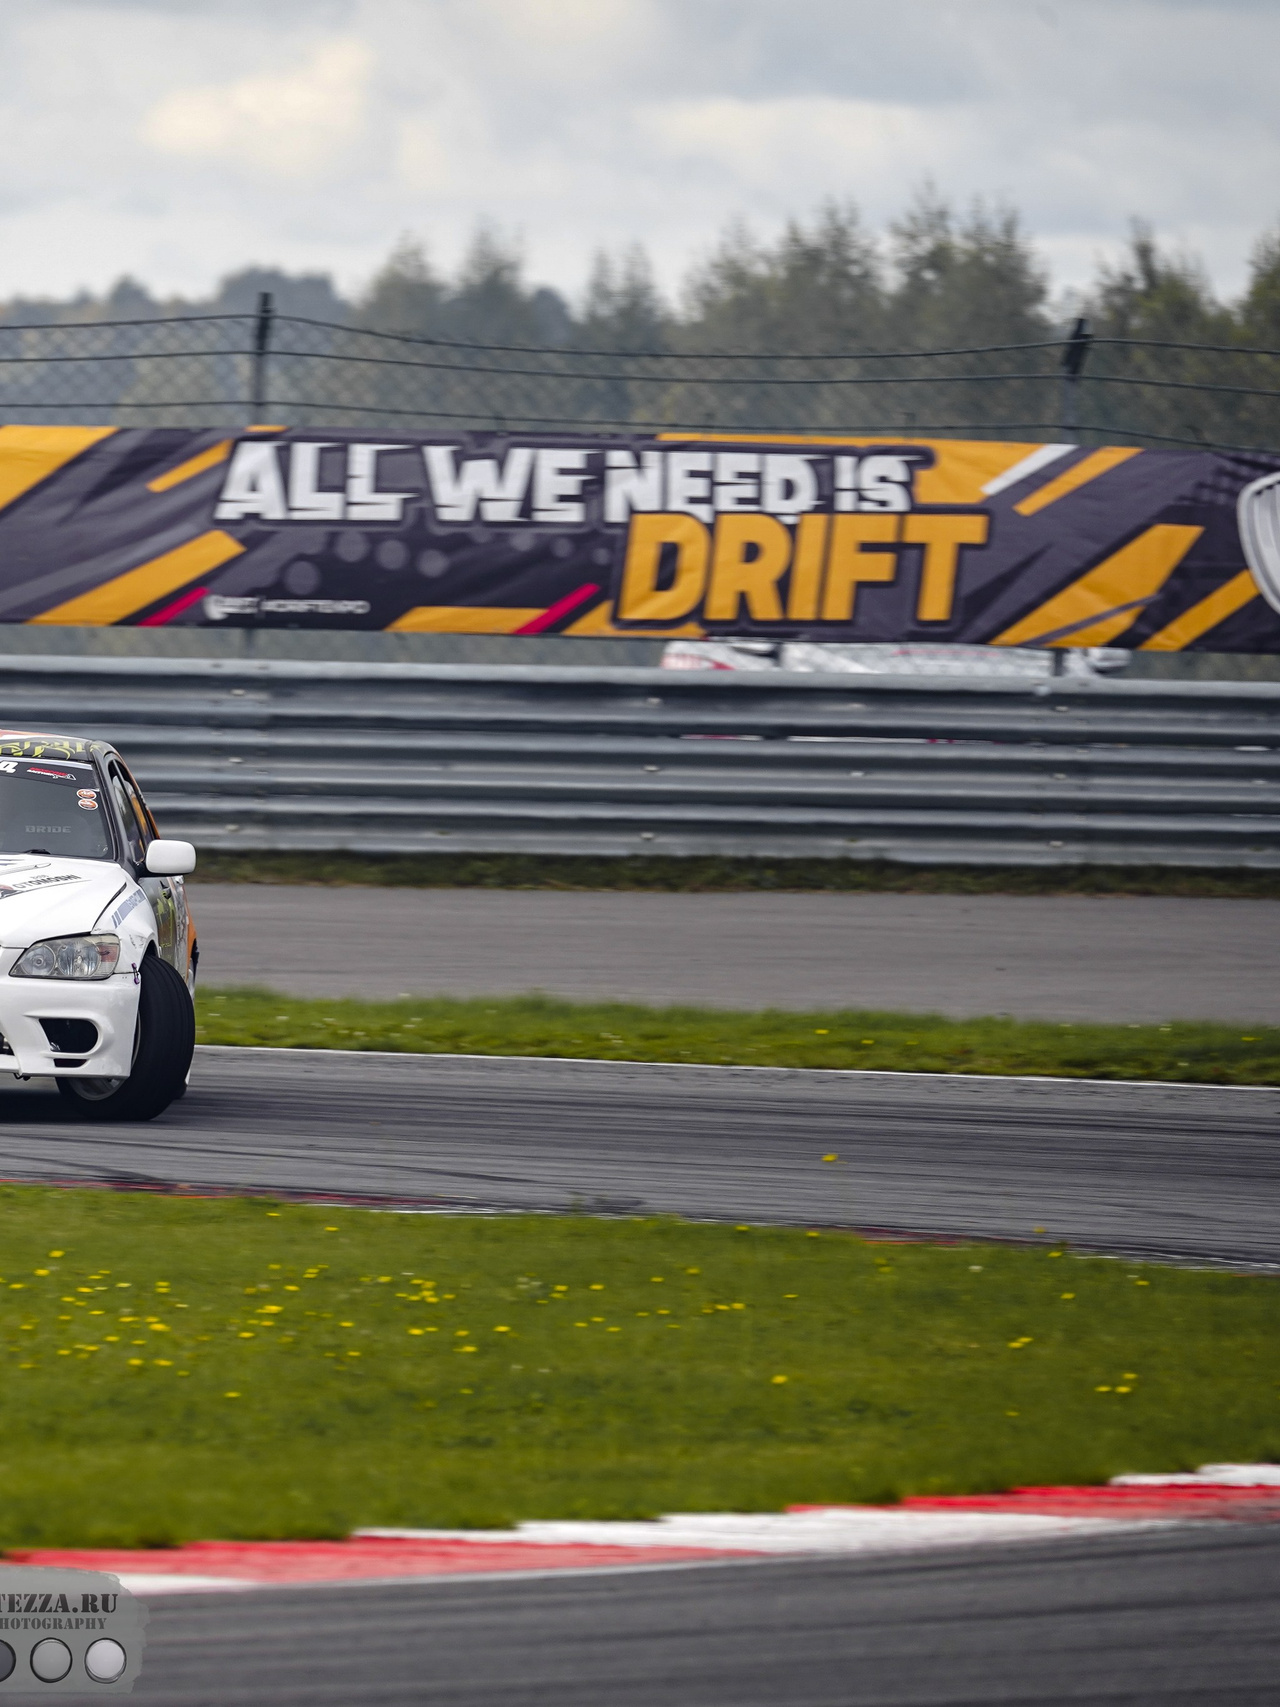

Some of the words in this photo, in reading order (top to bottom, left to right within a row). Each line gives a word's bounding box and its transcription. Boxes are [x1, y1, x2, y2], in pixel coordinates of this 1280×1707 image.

[214, 440, 420, 521] ALL
[423, 445, 604, 522] WE
[604, 449, 831, 525] NEED
[833, 454, 926, 513] IS
[617, 513, 990, 622] DRIFT
[24, 825, 72, 833] BRIDE
